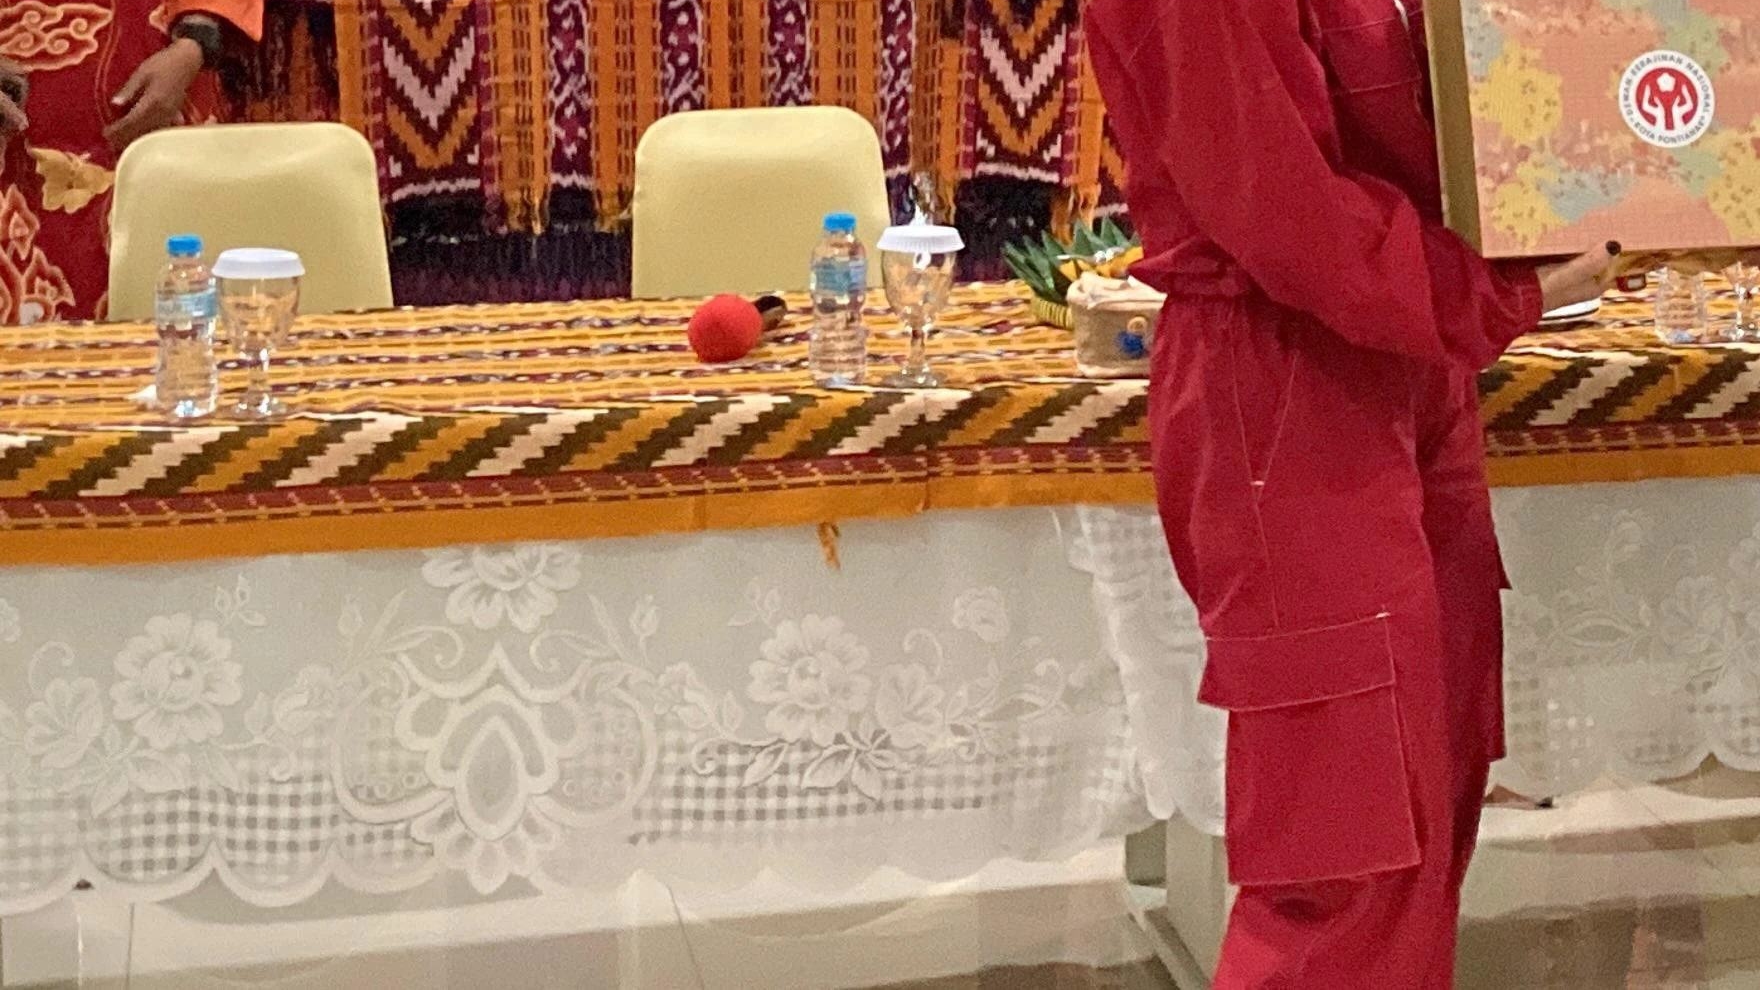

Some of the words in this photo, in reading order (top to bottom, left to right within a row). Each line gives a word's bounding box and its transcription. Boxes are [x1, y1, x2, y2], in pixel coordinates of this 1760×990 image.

[1623, 78, 1633, 116] DEWAN
[1686, 62, 1710, 112] NASIONAL
[1634, 121, 1655, 139] KOTA
[1658, 121, 1704, 143] PONTIANAK
